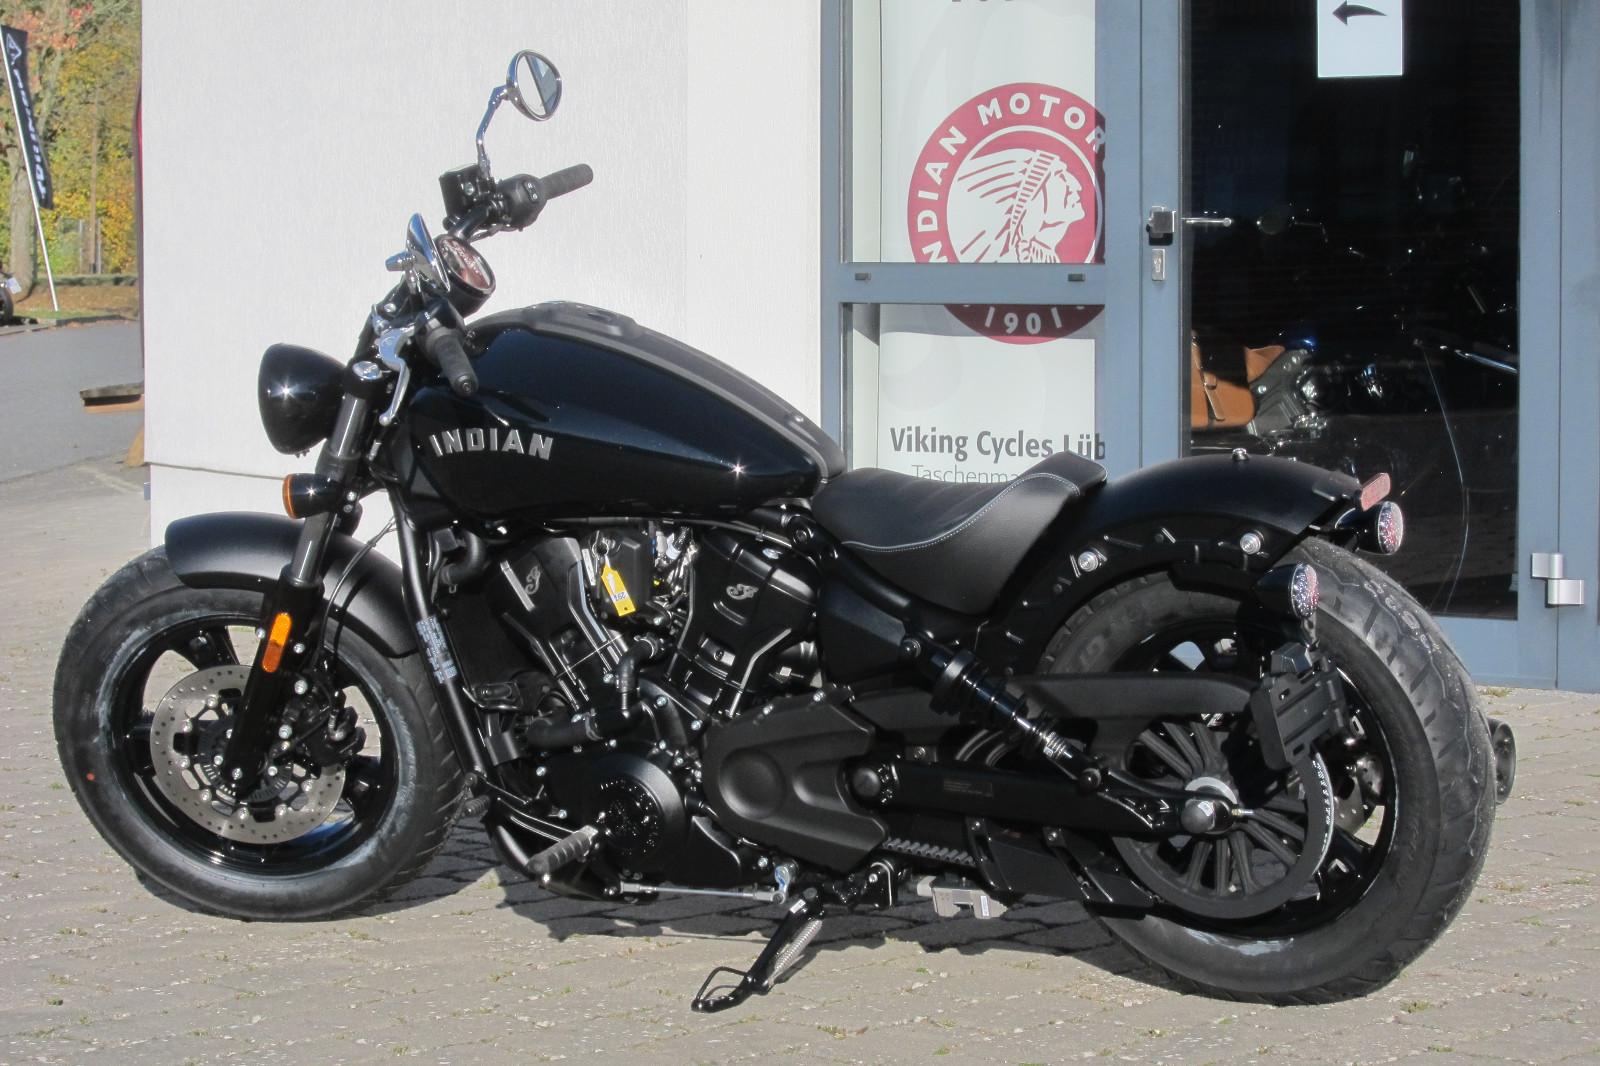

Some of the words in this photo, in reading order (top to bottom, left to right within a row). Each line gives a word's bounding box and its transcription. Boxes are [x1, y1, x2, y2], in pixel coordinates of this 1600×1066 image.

[916, 125, 968, 263] NDIAN
[984, 305, 1063, 335] 1901
[429, 427, 554, 460] INDIAN
[889, 425, 969, 462] Viking
[976, 429, 1053, 464] Cycles
